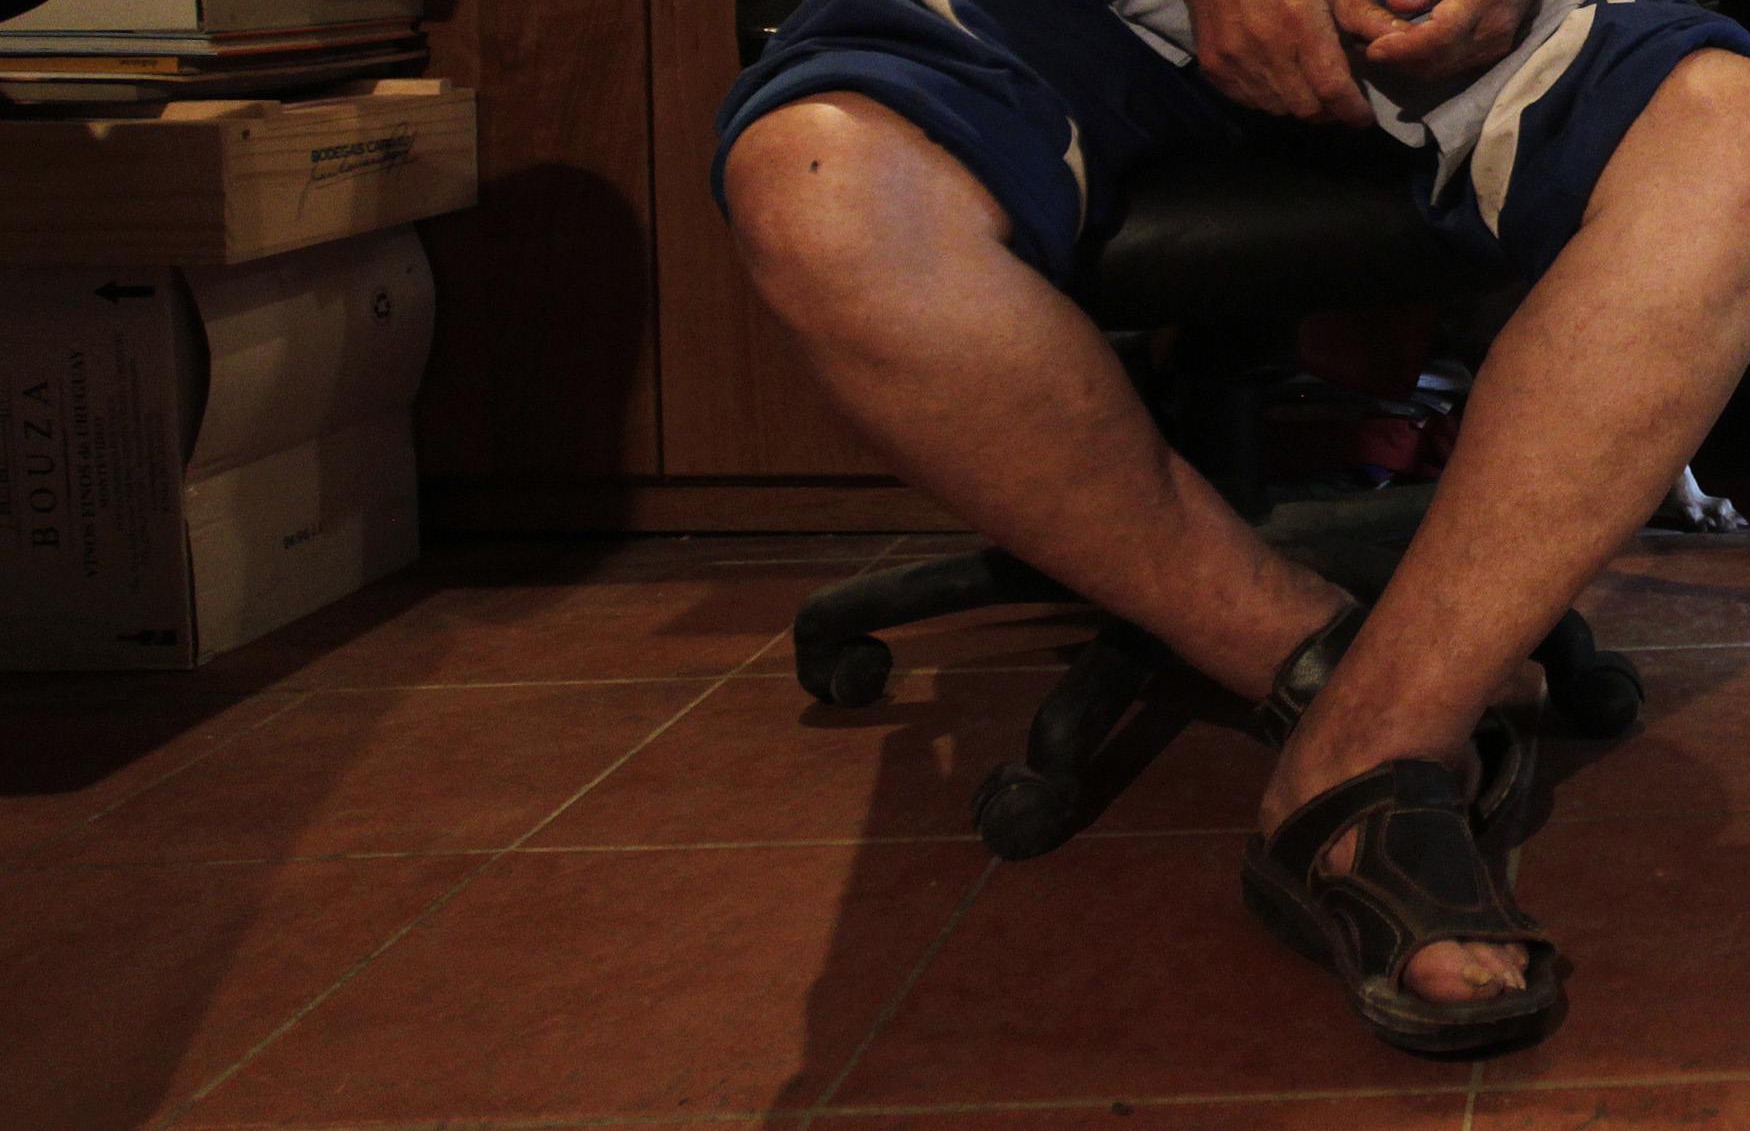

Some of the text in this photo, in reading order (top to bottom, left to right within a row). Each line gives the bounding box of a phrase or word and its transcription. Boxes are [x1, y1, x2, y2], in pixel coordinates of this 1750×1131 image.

[69, 347, 91, 437] URUGUAY
[22, 379, 60, 549] BOUZA
[79, 465, 96, 518] FINOS
[81, 524, 99, 579] VINOS
